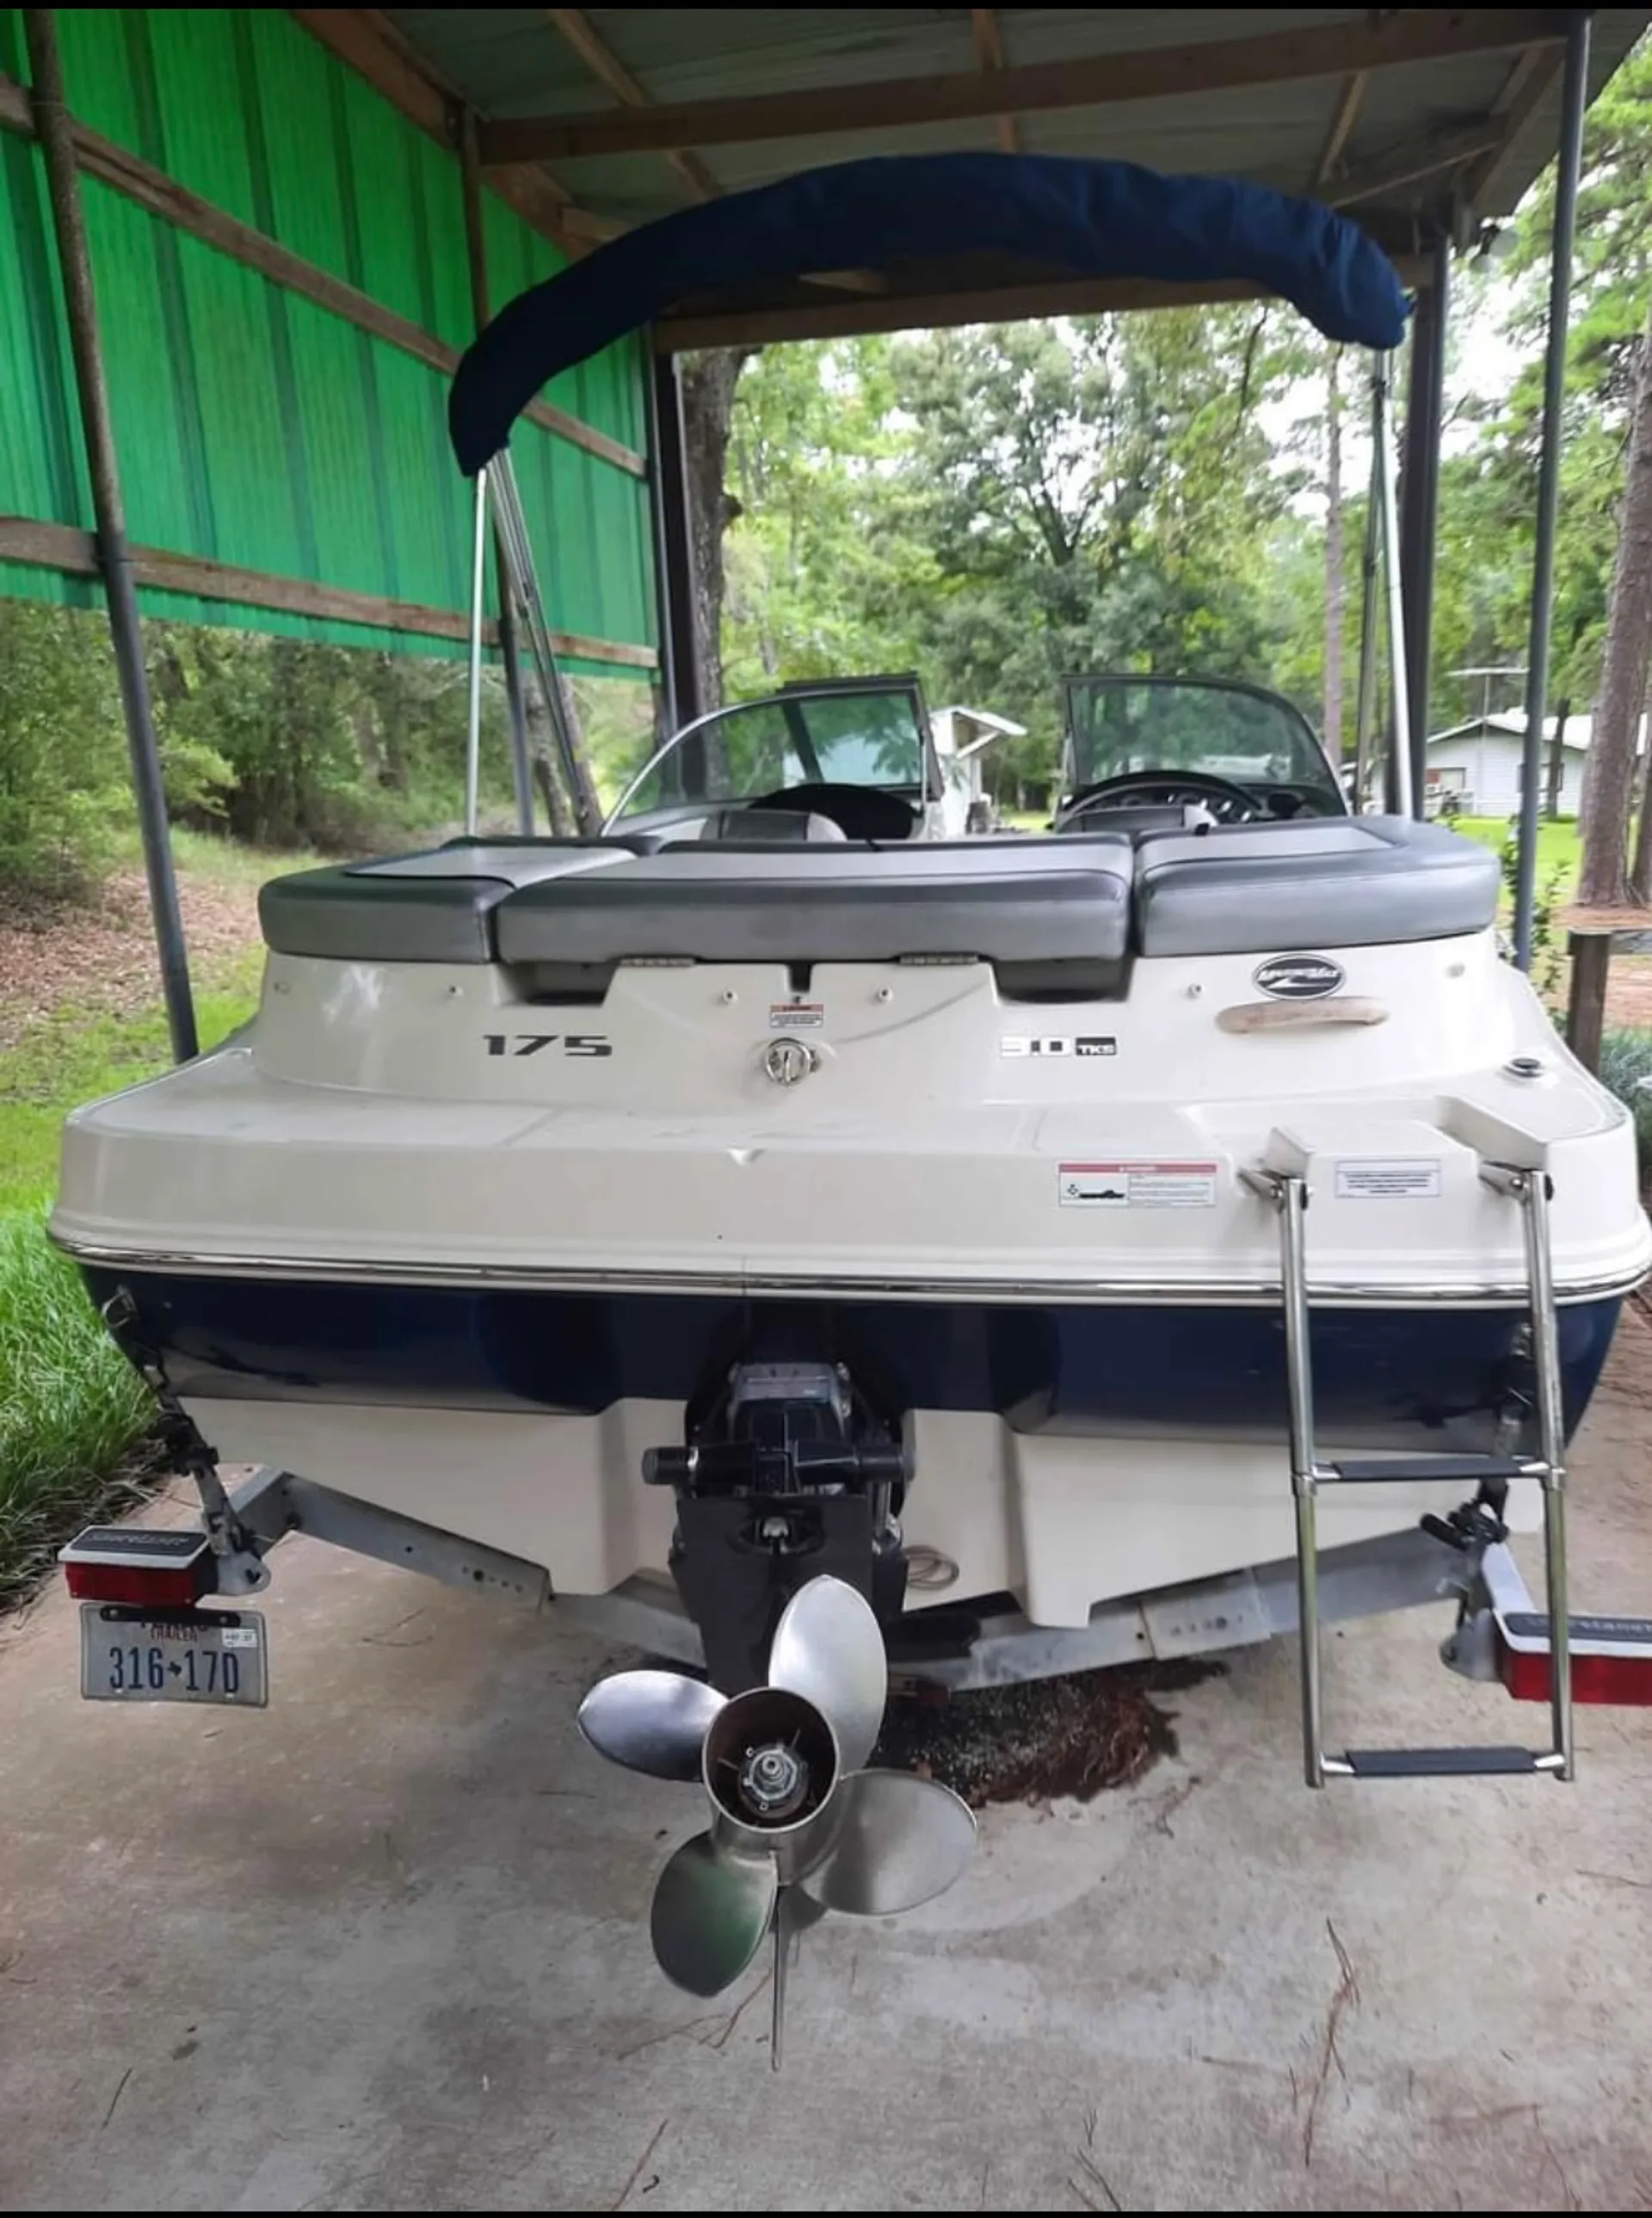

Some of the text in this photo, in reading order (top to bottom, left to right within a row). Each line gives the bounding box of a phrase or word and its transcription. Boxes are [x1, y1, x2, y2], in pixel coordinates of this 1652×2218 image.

[483, 1035, 612, 1057] 175
[1076, 1042, 1116, 1057] TKS
[108, 1646, 239, 1694] 316 17D
